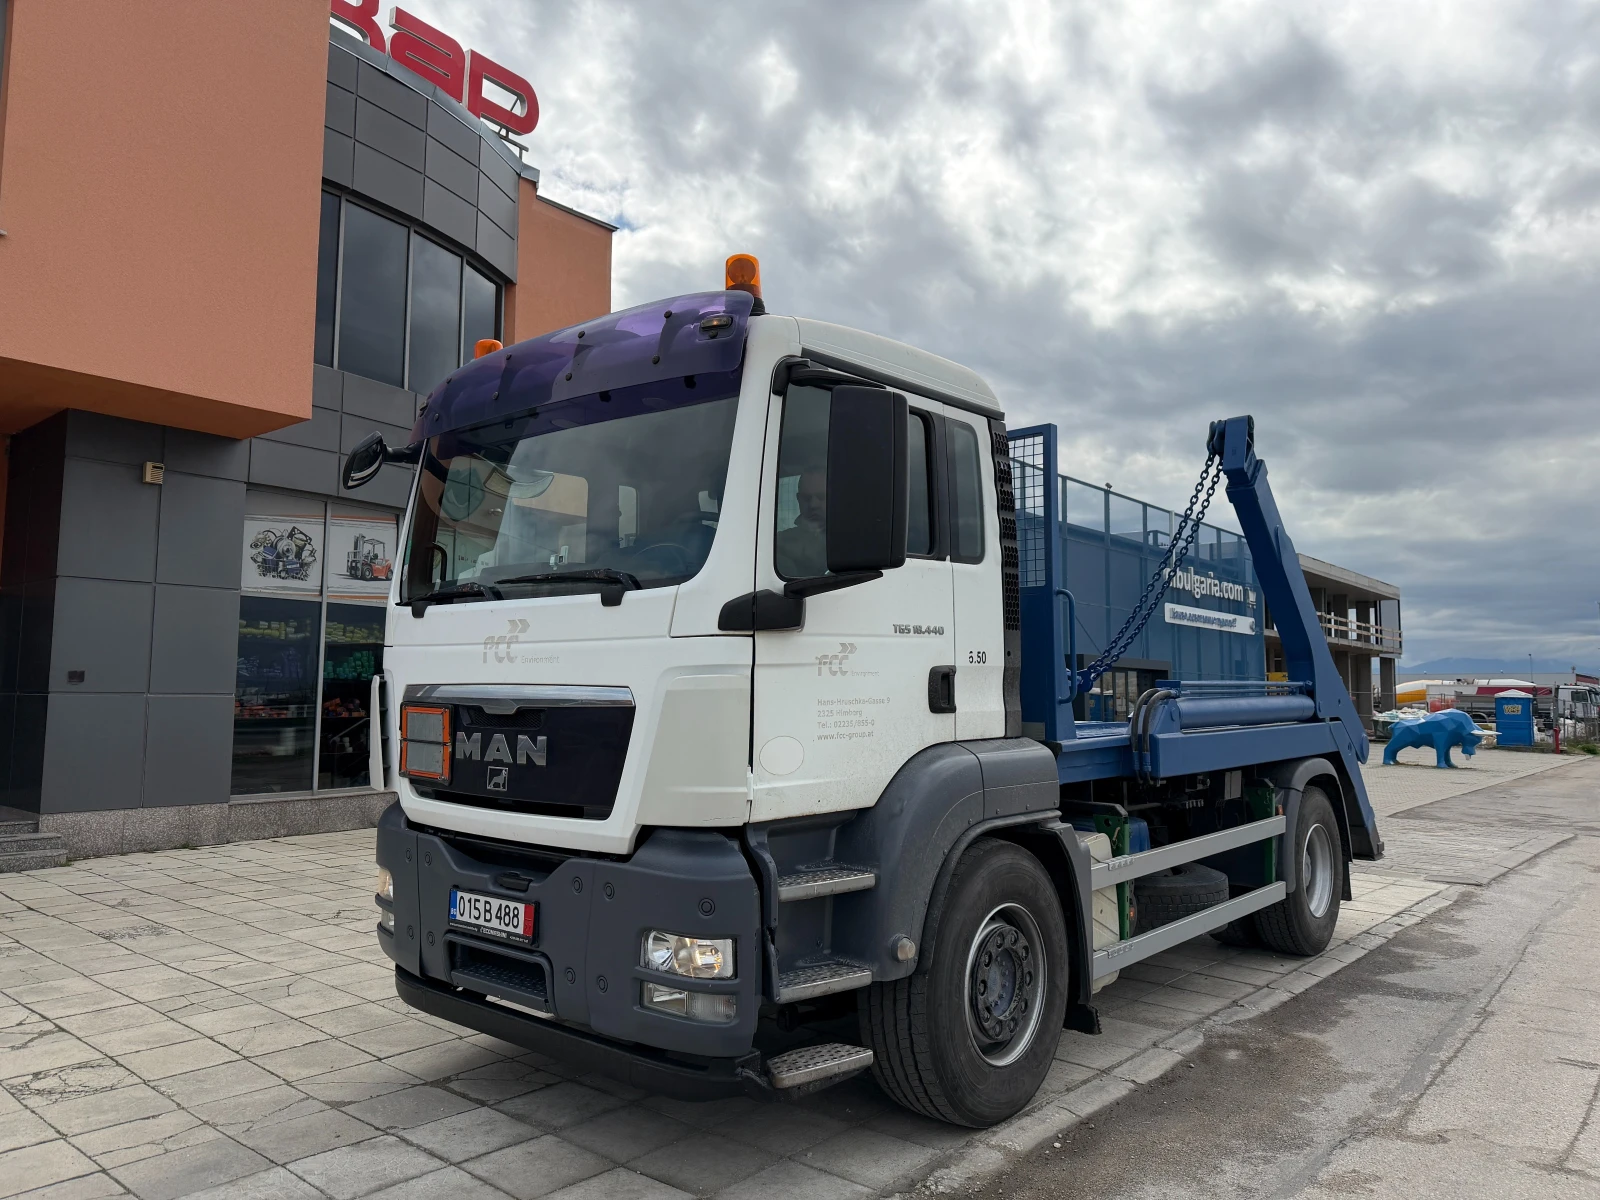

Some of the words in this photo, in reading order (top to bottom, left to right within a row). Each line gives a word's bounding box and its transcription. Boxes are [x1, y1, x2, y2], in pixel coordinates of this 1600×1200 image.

[893, 623, 911, 635] TGS
[912, 624, 945, 636] 18.440
[817, 709, 834, 718] 2325
[455, 731, 548, 766] MAN
